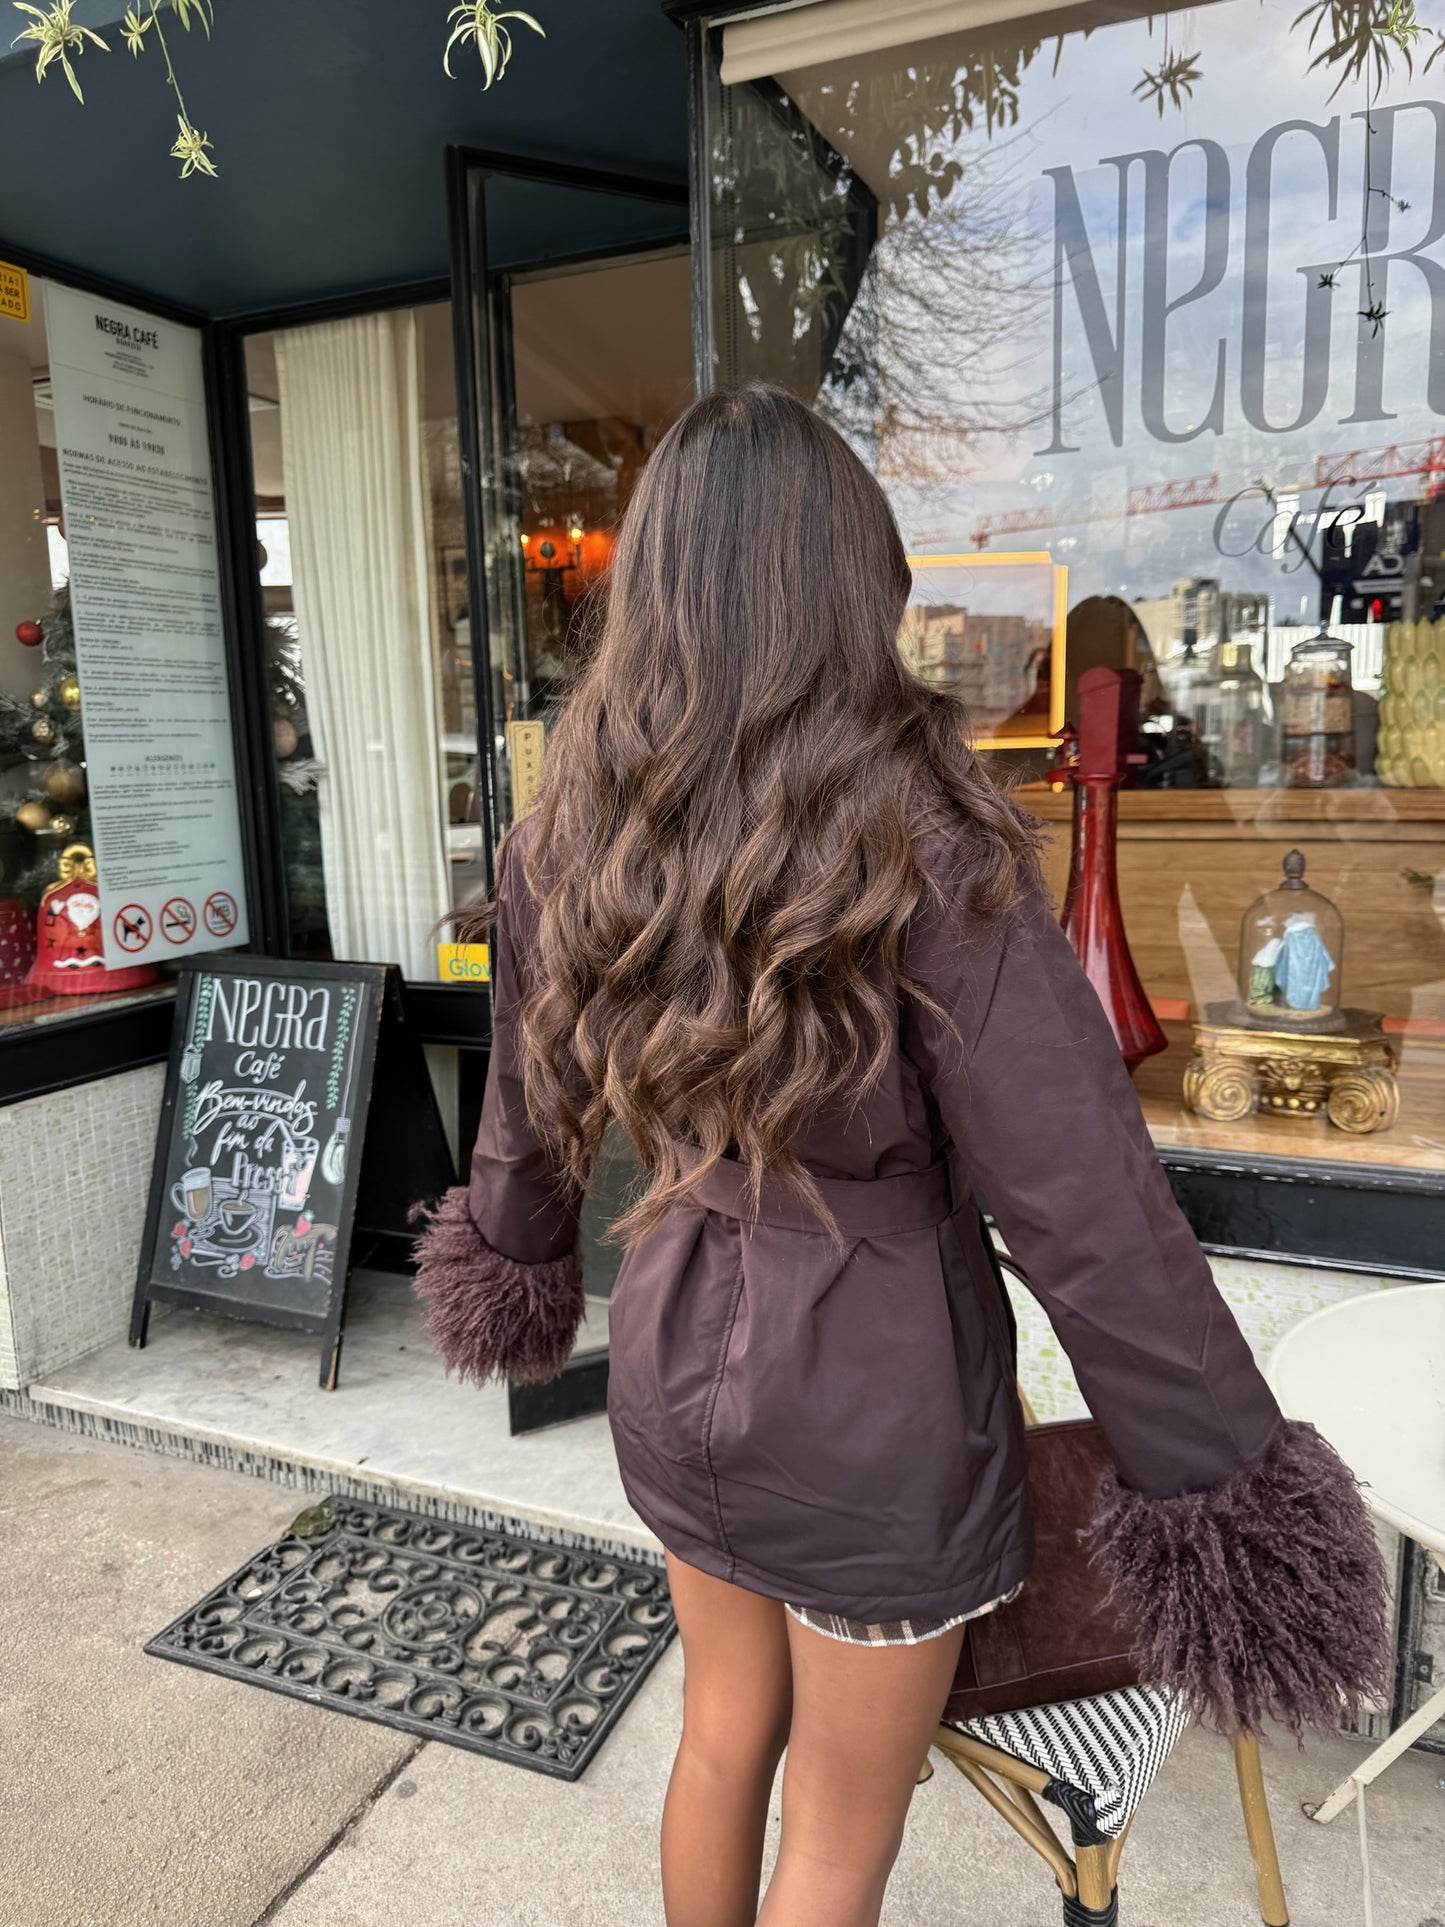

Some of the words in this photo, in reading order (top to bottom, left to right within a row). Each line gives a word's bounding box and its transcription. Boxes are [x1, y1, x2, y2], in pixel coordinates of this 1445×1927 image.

[95, 314, 132, 340] NEGRA
[133, 328, 159, 349] CAFÉ
[1212, 475, 1377, 574] Café
[234, 1050, 286, 1084] Café
[192, 1079, 318, 1136] Bem-vindos
[236, 1114, 260, 1131] ao
[209, 1120, 250, 1166] fim
[253, 1119, 280, 1160] da
